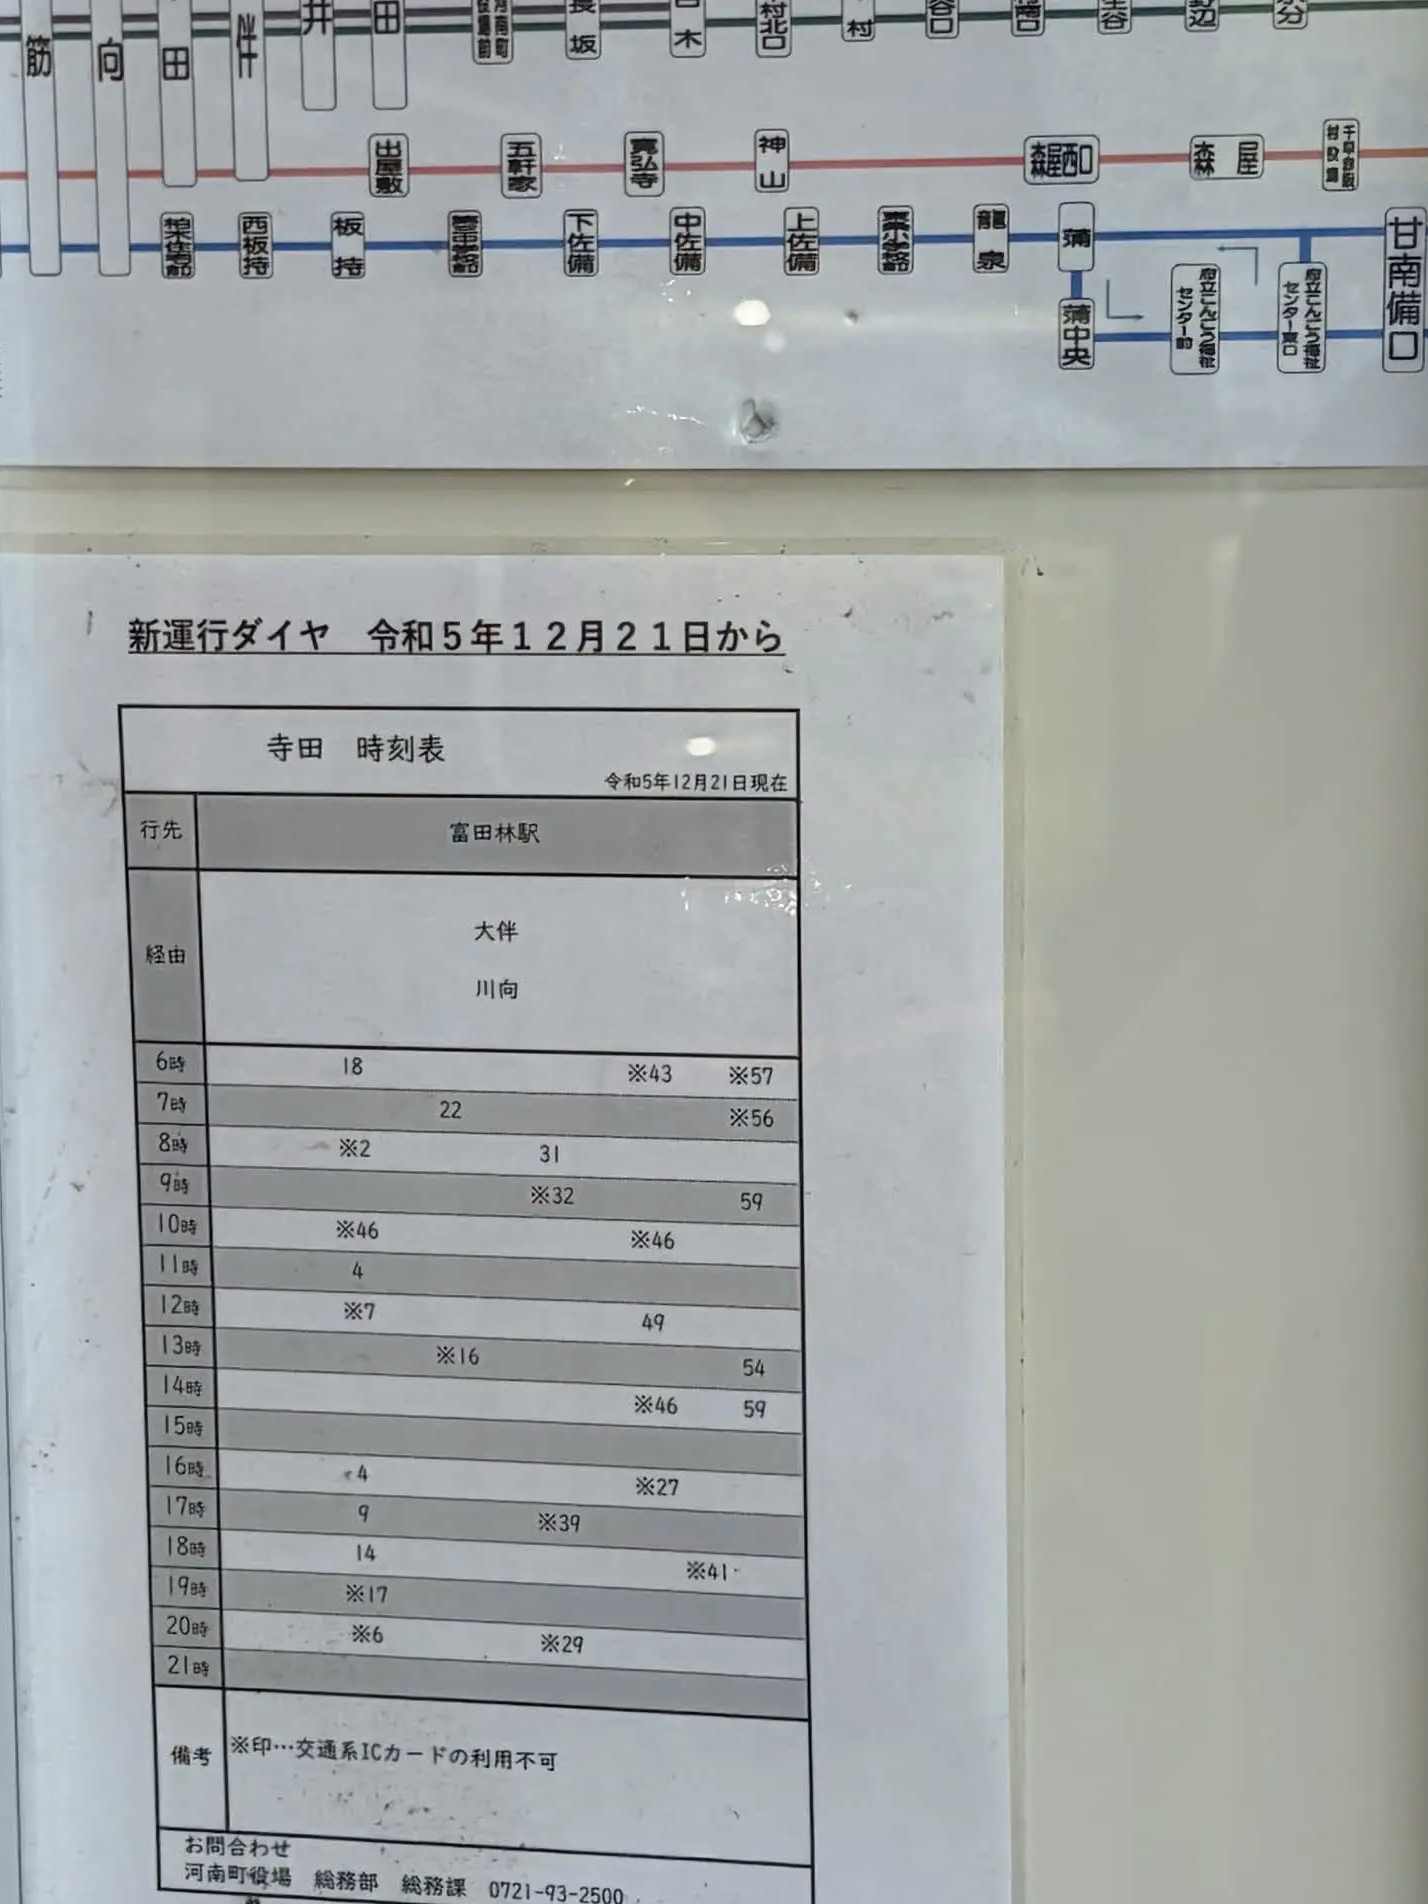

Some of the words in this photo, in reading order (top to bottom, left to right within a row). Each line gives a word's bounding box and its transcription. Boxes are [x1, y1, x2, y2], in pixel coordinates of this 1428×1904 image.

[375, 139, 404, 194] 出屋敷
[630, 138, 658, 189] 寛弘寺
[758, 135, 786, 189] 神山
[1030, 141, 1094, 179] 森屋西口
[1193, 140, 1260, 177] 森屋
[242, 216, 271, 275] 西板持
[332, 217, 365, 277] 板持
[567, 213, 596, 274] 下佐備
[673, 212, 701, 272] 中佐備
[786, 212, 819, 272] 上佐備
[977, 209, 1007, 271] 龍泉
[1386, 215, 1424, 361] 甘南備口
[127, 617, 331, 652] 新運行ダイヤ
[267, 734, 324, 763] 寺田
[356, 734, 446, 764] 時刻表
[604, 771, 789, 794] 令和5年12月21日現在
[139, 818, 184, 842] 行先
[449, 821, 541, 846] 富田林駅
[474, 918, 519, 944] 大伴
[145, 943, 187, 966] 経由
[474, 977, 519, 1002] 川向
[156, 1051, 187, 1073] 6時
[343, 1056, 363, 1076] 18
[627, 1063, 673, 1085] ※43
[729, 1065, 774, 1087] ※57
[156, 1091, 187, 1113] 7時
[439, 1100, 463, 1120] 22
[729, 1108, 775, 1129] ※56
[158, 1133, 188, 1155] 8時
[338, 1137, 372, 1159] ※2
[539, 1144, 560, 1164] 31
[159, 1172, 190, 1194] 9時
[530, 1185, 575, 1207] ※32
[739, 1192, 763, 1212] 59
[158, 1213, 198, 1236] 10時
[335, 1219, 380, 1241] ※46
[630, 1229, 676, 1251] ※46
[159, 1254, 199, 1276] 11時
[351, 1261, 364, 1281] 4
[159, 1294, 201, 1317] 12時
[343, 1301, 376, 1322] ※7
[641, 1313, 666, 1333] 49
[161, 1335, 202, 1357] 13時
[436, 1345, 481, 1367] ※16
[742, 1358, 767, 1379] 54
[162, 1376, 204, 1398] 14時
[633, 1394, 679, 1416] ※46
[742, 1399, 767, 1420] 59
[163, 1416, 204, 1438] 15時
[164, 1456, 205, 1478] 16時
[355, 1464, 369, 1483] 4
[635, 1476, 680, 1498] ※27
[165, 1496, 206, 1519] 17時
[357, 1504, 370, 1523] 9
[537, 1512, 581, 1534] ※39
[166, 1536, 206, 1559] 18時
[355, 1544, 377, 1562] 14
[685, 1560, 729, 1582] ※41
[168, 1576, 209, 1599] 19時
[345, 1583, 388, 1605] ※17
[165, 1616, 209, 1639] 20時
[351, 1624, 385, 1646] ※6
[540, 1633, 584, 1655] ※29
[167, 1655, 210, 1678] 21時
[170, 1745, 213, 1767] 備考
[183, 1835, 292, 1860] お問合わせ
[183, 1862, 293, 1889] 河南町役場
[313, 1869, 380, 1893] 総務部
[401, 1875, 468, 1898] 総務課
